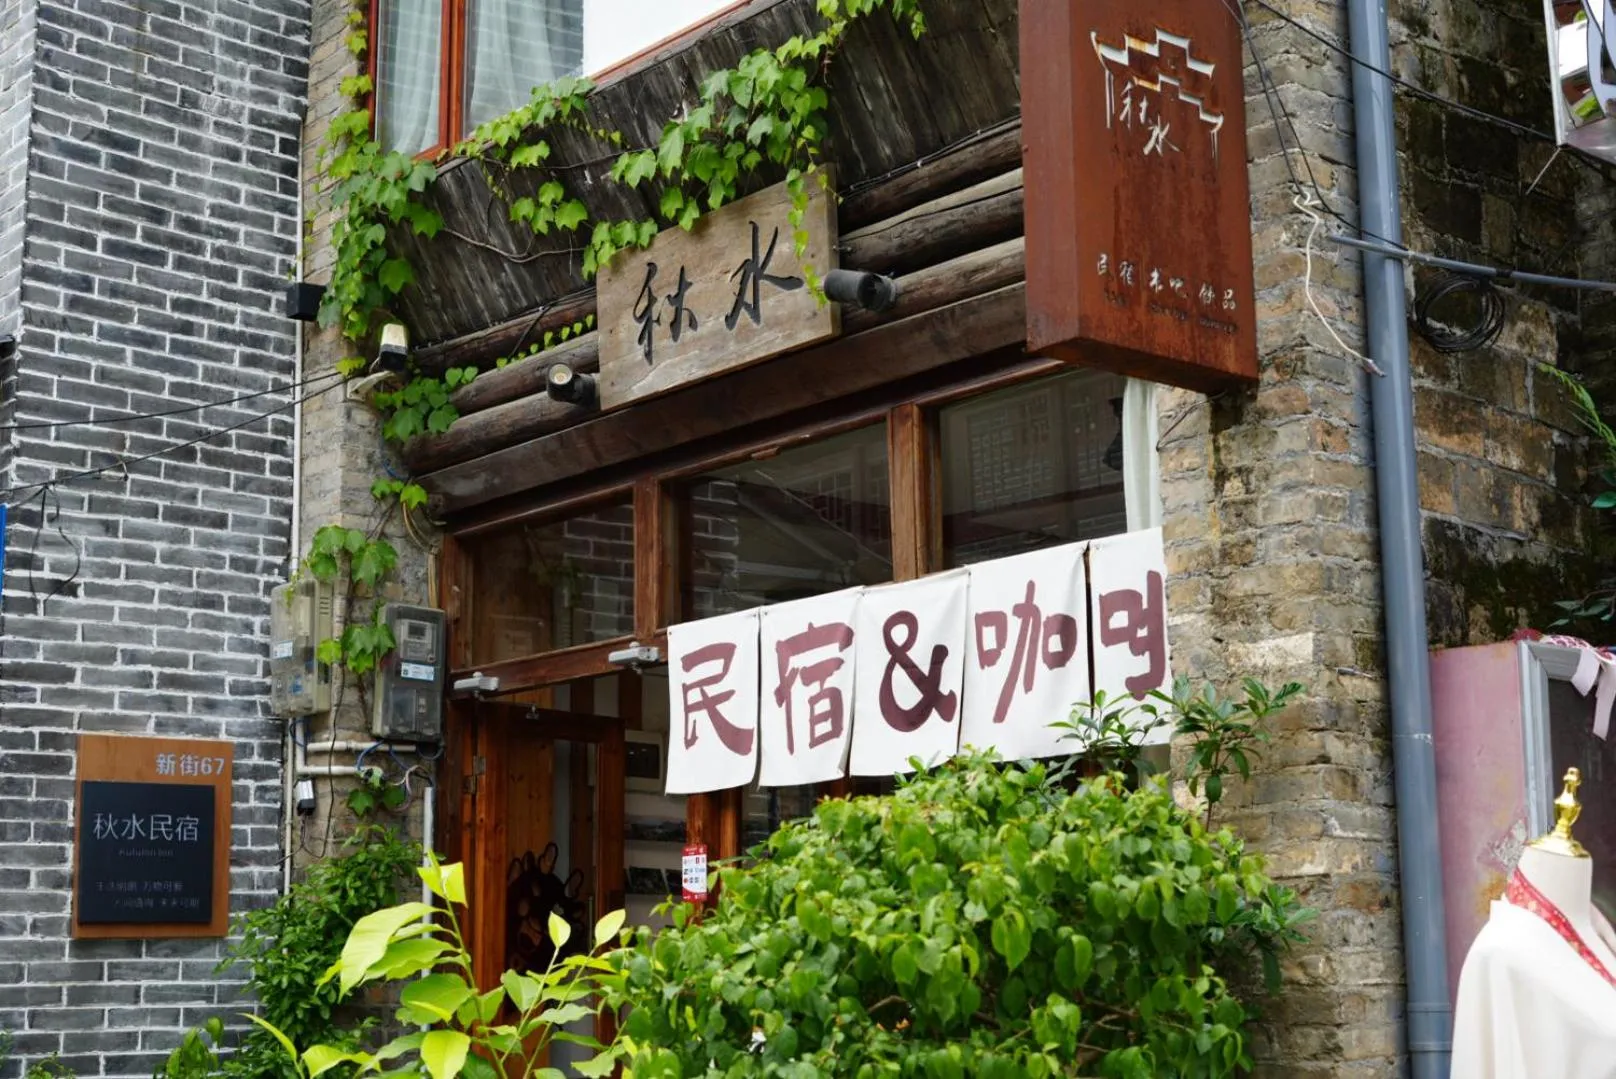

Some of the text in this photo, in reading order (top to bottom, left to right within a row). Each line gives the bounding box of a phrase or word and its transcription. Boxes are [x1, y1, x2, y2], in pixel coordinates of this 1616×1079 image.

[633, 220, 804, 366] 秋水
[155, 752, 226, 777] 新街67
[92, 812, 200, 842] 秋水民宿
